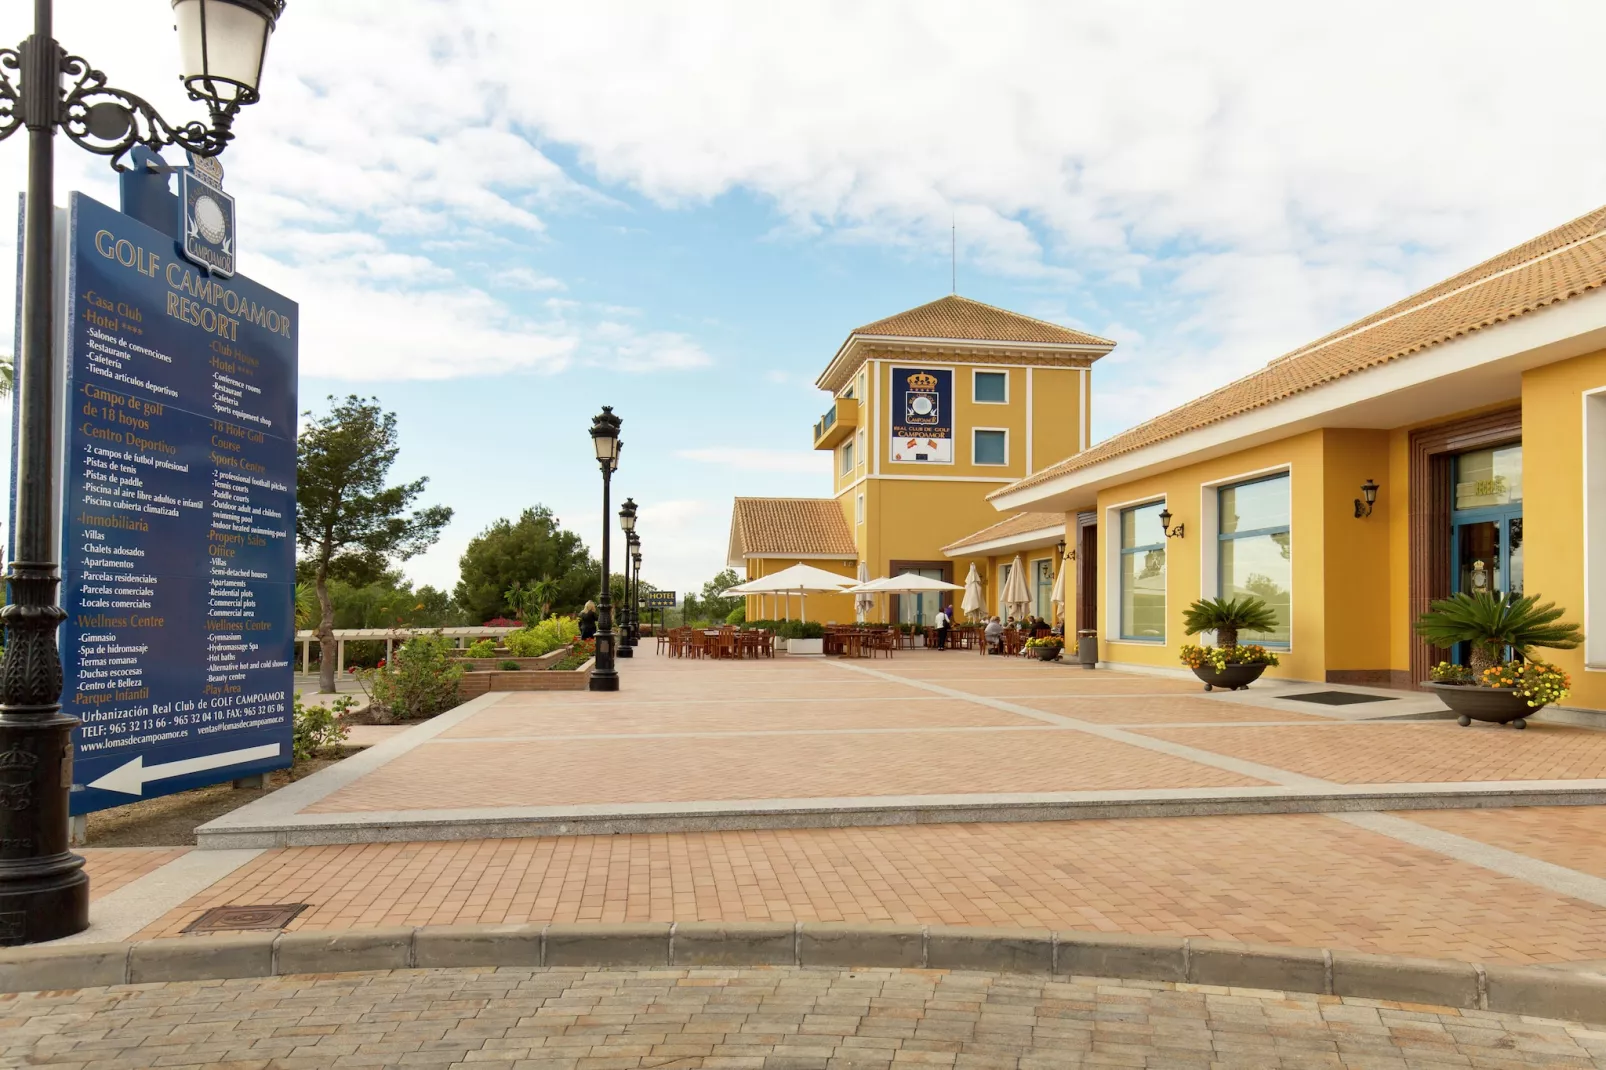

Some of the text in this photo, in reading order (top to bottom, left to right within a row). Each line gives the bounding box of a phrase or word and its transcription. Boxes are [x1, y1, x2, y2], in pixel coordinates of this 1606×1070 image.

[188, 237, 231, 273] CAMPOAMOR
[95, 229, 291, 339] GOLF CAMPOAMOR
[117, 302, 142, 322] Club
[167, 290, 240, 342] RESORT
[118, 337, 127, 348] de
[128, 342, 172, 364] convenciones
[145, 380, 179, 398] deportivos
[245, 384, 262, 395] rooms
[127, 395, 140, 410] de
[143, 401, 164, 417] golf
[83, 400, 149, 431] de 18 hoyos
[232, 409, 259, 422] equipment
[259, 416, 272, 428] shop
[226, 424, 245, 439] Hole
[897, 430, 946, 439] CAMPOAMOR
[125, 432, 176, 455] Deportivo
[211, 434, 241, 452] Course
[93, 447, 122, 460] campos
[123, 451, 132, 461] de
[155, 459, 189, 473] profesional
[240, 458, 266, 474] Centre
[109, 460, 118, 471] de
[120, 463, 137, 474] tenis
[108, 473, 118, 483] de
[119, 477, 143, 488] paddle
[219, 472, 288, 492] professional football pitches
[232, 485, 249, 494] courts
[113, 486, 120, 496] al
[121, 488, 136, 499] aire
[137, 490, 152, 501] libre
[153, 492, 176, 505] adultos
[182, 497, 204, 509] infantil
[233, 495, 250, 504] courts
[113, 499, 141, 512] cubierta
[143, 503, 179, 517] climatizada
[238, 504, 252, 514] adult
[252, 507, 262, 515] and
[262, 509, 282, 519] children
[212, 511, 253, 524] swimming pool
[232, 523, 250, 533] heated
[247, 534, 267, 547] Sales
[113, 546, 145, 557] adosados
[208, 544, 236, 557] Office
[114, 573, 158, 584] residenciales
[250, 569, 268, 579] houses
[114, 587, 154, 597] comerciales
[240, 590, 254, 599] plots
[111, 599, 151, 609] comerciales
[243, 599, 256, 609] plots
[130, 614, 165, 628] Centre
[245, 619, 272, 631] Centre
[96, 645, 105, 654] de
[107, 643, 149, 655] hidromasaje
[248, 642, 259, 652] Spa
[108, 657, 138, 665] romanas
[220, 652, 236, 662] baths
[239, 661, 249, 670] hot
[249, 660, 260, 669] and
[260, 660, 272, 668] cold
[109, 667, 143, 677] escocesas
[228, 672, 246, 681] centre
[107, 679, 116, 689] de
[117, 678, 142, 688] Belleza
[223, 684, 241, 693] Area
[115, 687, 149, 700] Infantil
[81, 691, 285, 723] Urbanización Real Club de GOLF CAMPOAMOR
[81, 726, 107, 738] TELF:
[109, 722, 127, 735] 965
[128, 720, 140, 732] 32
[143, 718, 153, 730] 13
[155, 717, 166, 728] 66
[173, 713, 188, 727] 965
[190, 713, 200, 724] 32
[202, 712, 212, 722] 04
[226, 709, 242, 719] FAX:
[243, 706, 256, 717] 965
[257, 705, 266, 715] 32
[267, 704, 275, 713] 05
[276, 703, 285, 712] 06
[80, 730, 189, 752] www.lomasdecampoamor.es
